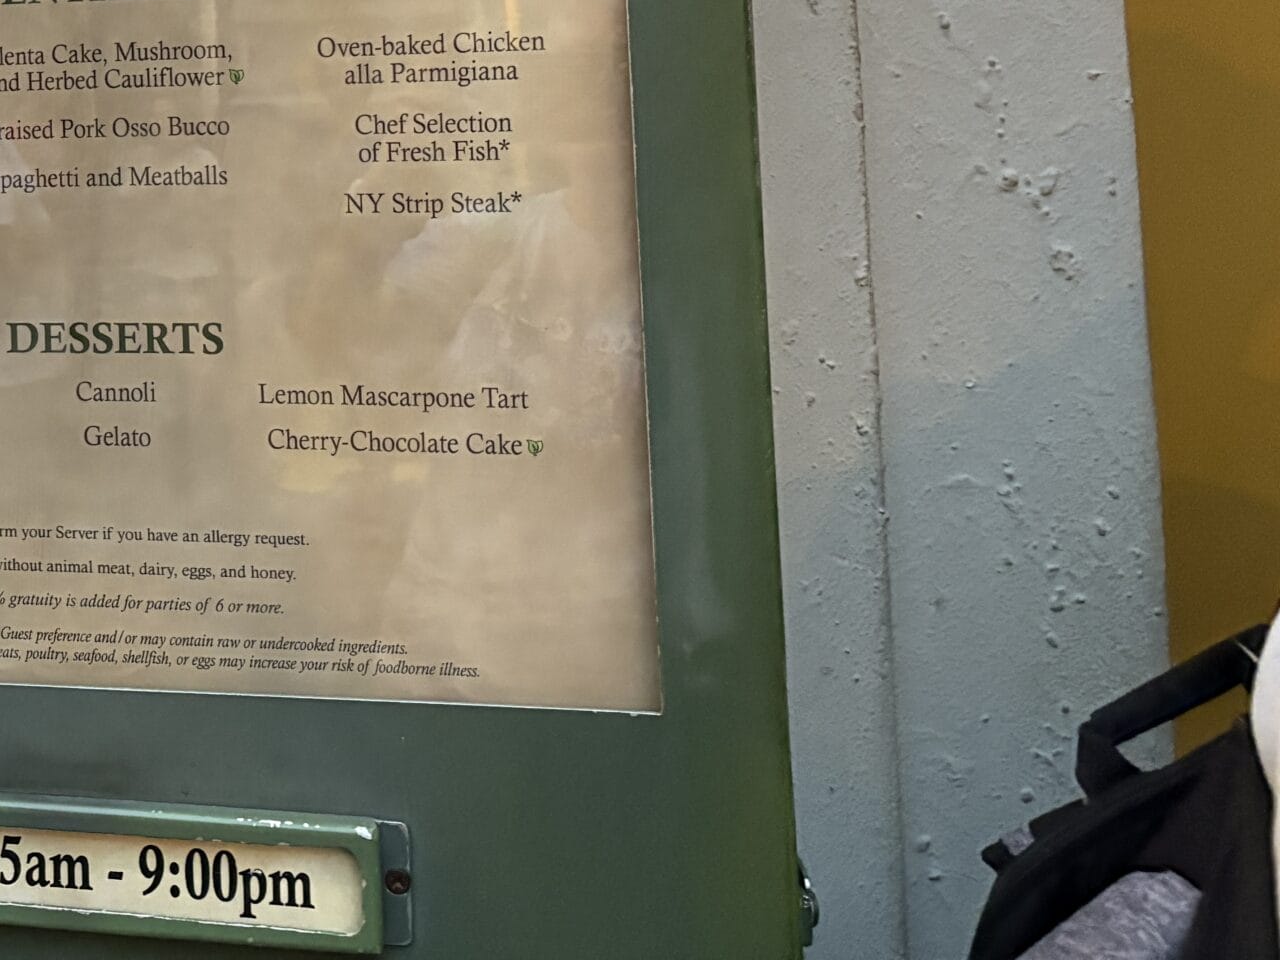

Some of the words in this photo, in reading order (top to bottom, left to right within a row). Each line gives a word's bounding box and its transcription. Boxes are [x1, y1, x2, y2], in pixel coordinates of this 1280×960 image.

[51, 43, 107, 67] Cake,
[114, 40, 232, 63] Mushroom,
[317, 33, 447, 58] Oven-baked
[453, 30, 545, 54] Chicken
[26, 69, 99, 92] Herbed
[104, 66, 225, 89] Cauliflower
[344, 63, 384, 85] alla
[390, 59, 519, 87] Parmigiana
[60, 117, 107, 139] Pork
[112, 117, 161, 138] Osso
[167, 116, 230, 136] Bucco
[355, 113, 409, 135] Chef
[413, 111, 513, 134] Selection
[359, 141, 382, 163] of
[385, 140, 446, 162] Fresh
[86, 166, 123, 187] and
[128, 165, 228, 186] Meatballs
[344, 192, 385, 214] NY
[392, 192, 444, 219] Strip
[6, 322, 224, 355] DESSERTS
[76, 381, 156, 403] Cannoli
[258, 383, 335, 405] Lemon
[340, 385, 476, 413] Mascarpone
[481, 387, 529, 409] Tart
[84, 425, 151, 447] Gelato
[268, 428, 459, 456] Cherry-Chocolate
[465, 432, 522, 456] Cake
[21, 528, 53, 541] your
[55, 525, 99, 540] Server
[102, 526, 114, 540] if
[117, 530, 143, 544] you
[147, 528, 178, 542] have
[182, 532, 200, 543] an
[203, 529, 251, 547] allergy
[254, 534, 309, 549] request.
[46, 559, 93, 573] animal
[97, 564, 135, 577] meat,
[138, 561, 177, 579] dairy,
[181, 567, 216, 581] eggs,
[220, 565, 246, 578] and
[250, 565, 296, 583] honey.
[7, 592, 62, 610] gratuity
[65, 593, 77, 608] is
[79, 593, 121, 609] added
[120, 594, 144, 613] for
[144, 597, 192, 614] parties
[195, 596, 212, 616] of
[215, 598, 224, 613] 6
[227, 602, 244, 613] or
[246, 603, 284, 614] more.
[0, 625, 33, 641] Guest
[34, 627, 92, 645] preference
[139, 635, 167, 649] may
[169, 634, 214, 648] contain
[217, 638, 241, 649] raw
[243, 639, 257, 649] or
[259, 636, 336, 652] undercooked
[338, 639, 408, 657] ingredients.
[24, 646, 69, 664] poultry,
[72, 647, 118, 666] seafood,
[121, 649, 171, 668] shellfish,
[176, 656, 190, 666] or
[191, 656, 216, 670] eggs
[219, 657, 246, 671] may
[249, 655, 297, 670] increase
[298, 660, 329, 674] your
[331, 658, 355, 672] risk
[357, 658, 370, 676] of
[371, 659, 437, 678] foodborne
[439, 662, 480, 678] illness.
[138, 844, 315, 919] 9:00pm
